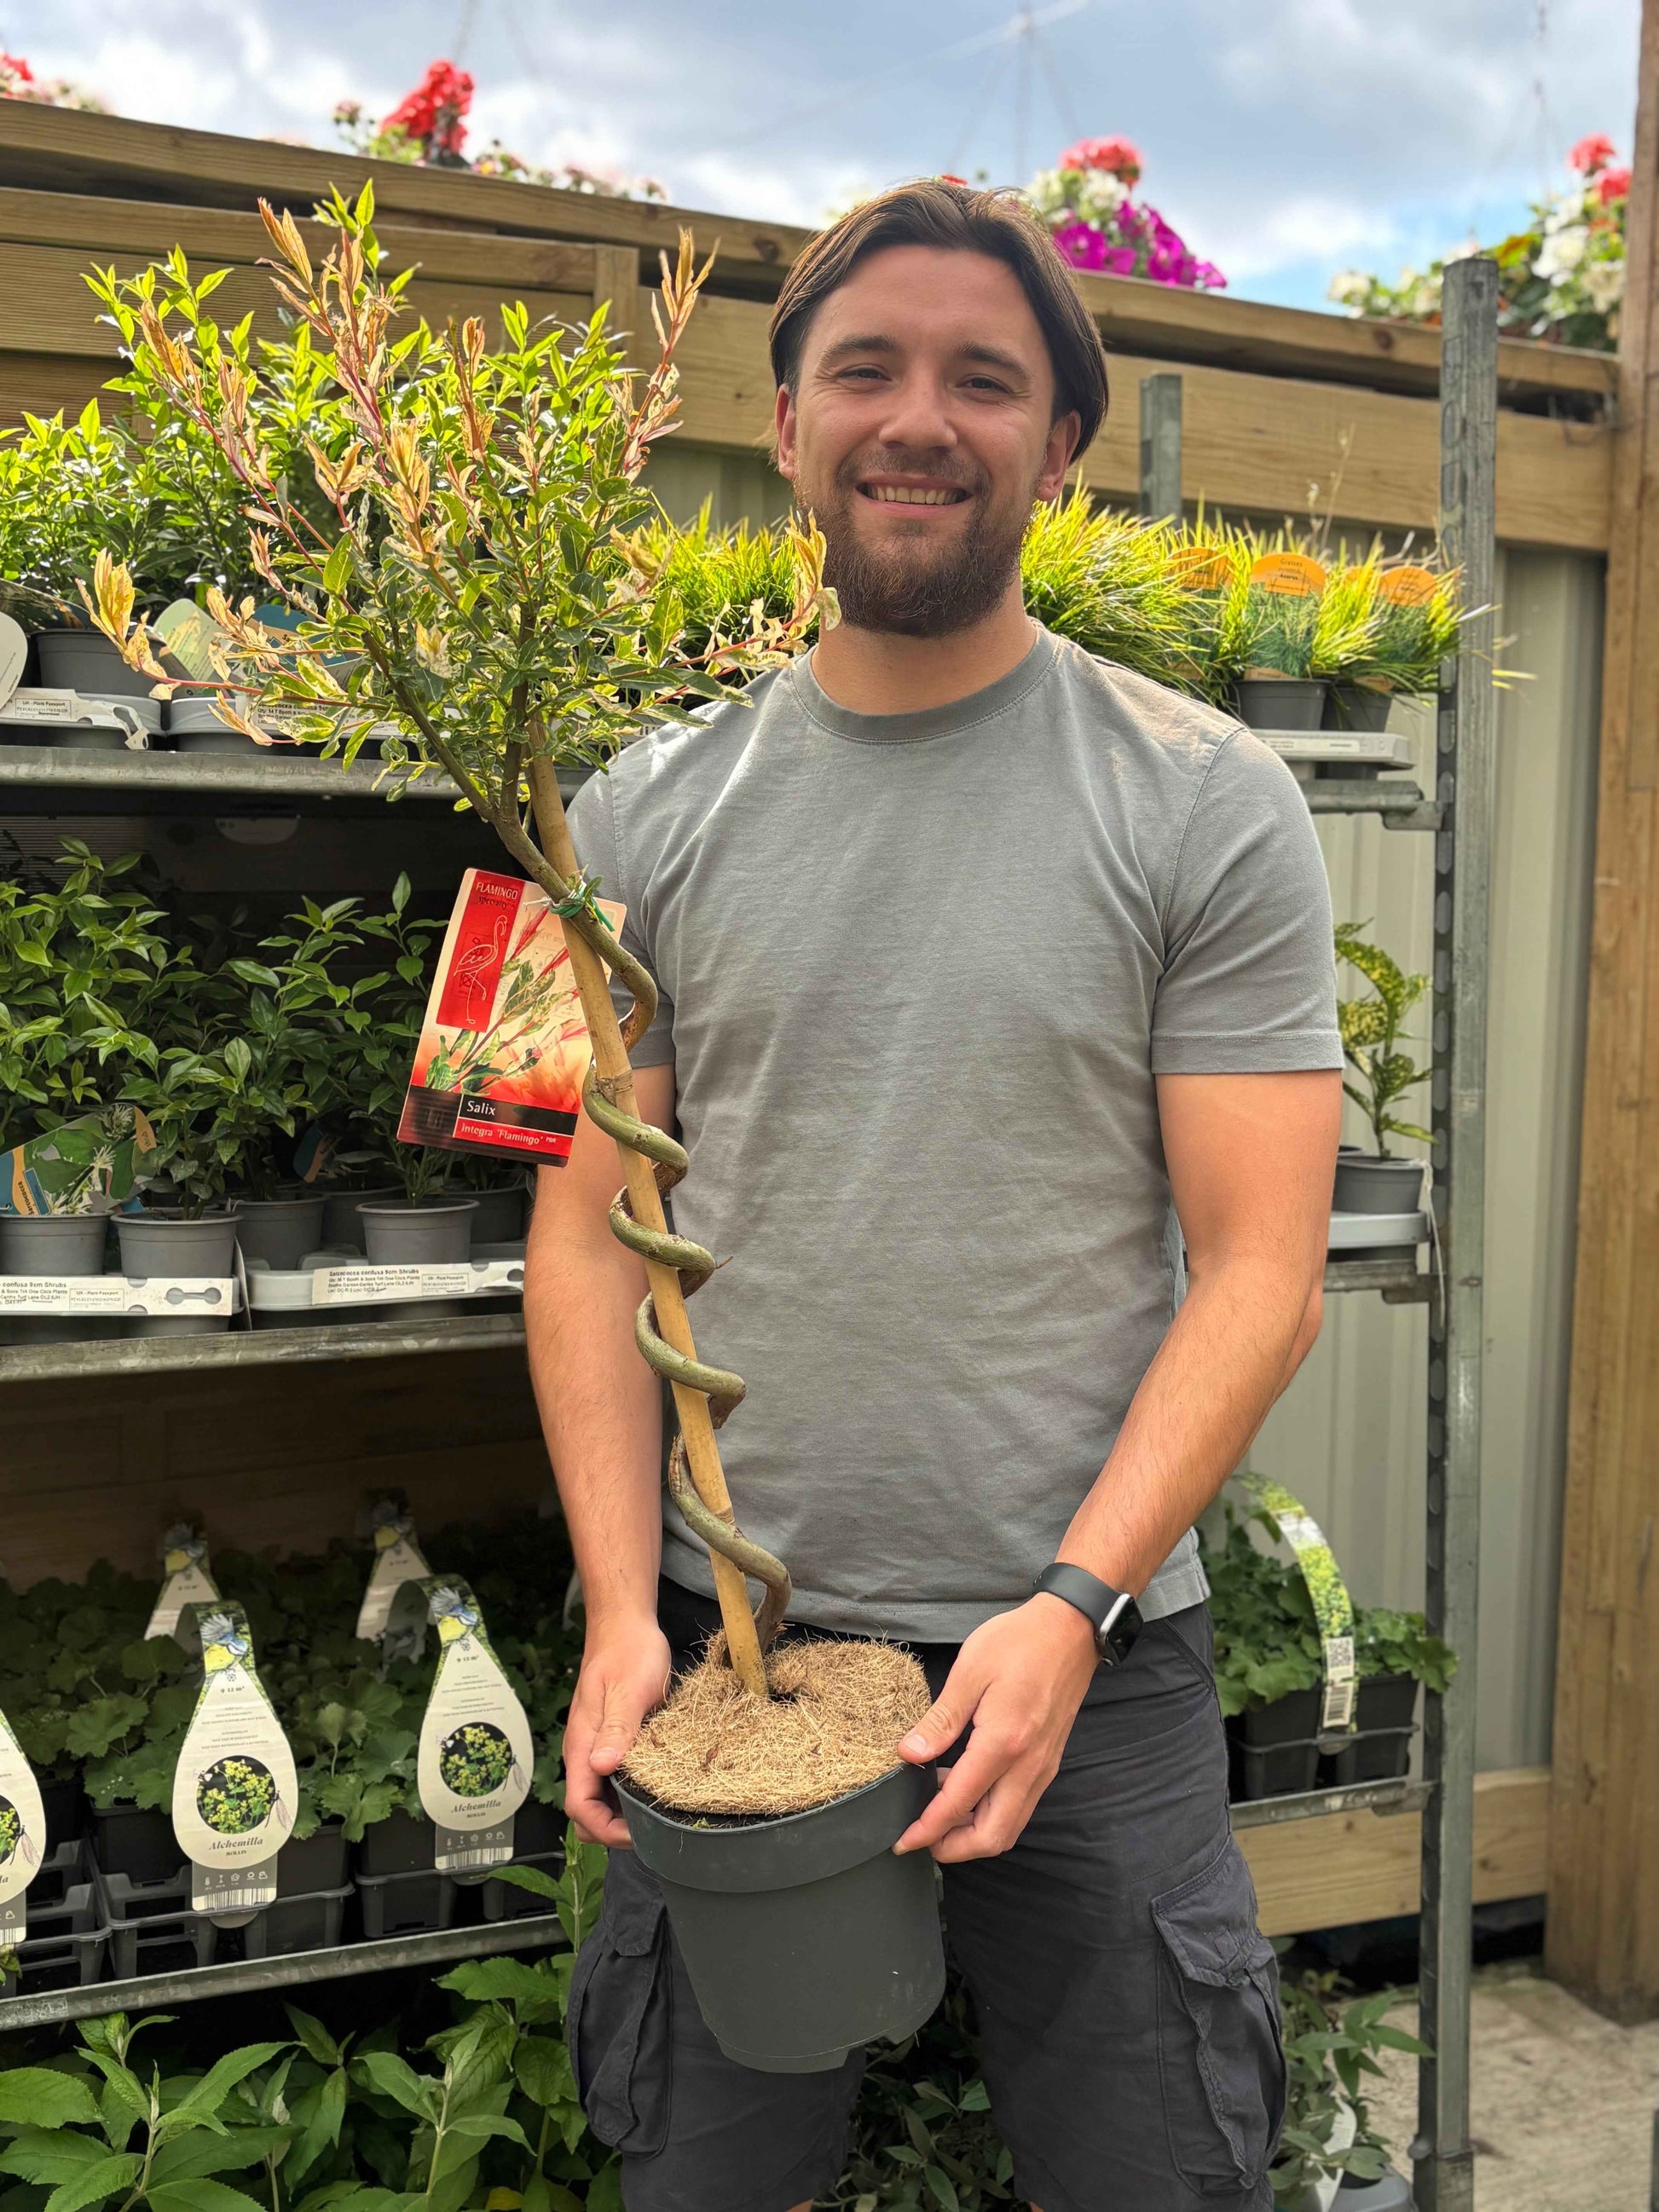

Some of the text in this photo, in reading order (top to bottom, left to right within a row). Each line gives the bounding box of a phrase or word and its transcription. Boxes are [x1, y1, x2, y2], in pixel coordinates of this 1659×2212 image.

[476, 881, 518, 900] FLAMINGO
[466, 1100, 496, 1116] Salix
[461, 1123, 494, 1137] integra
[18, 1181, 35, 1216] Sarcococca
[451, 1799, 501, 1814] Alchemilla
[209, 1837, 263, 1851] Alchemilla
